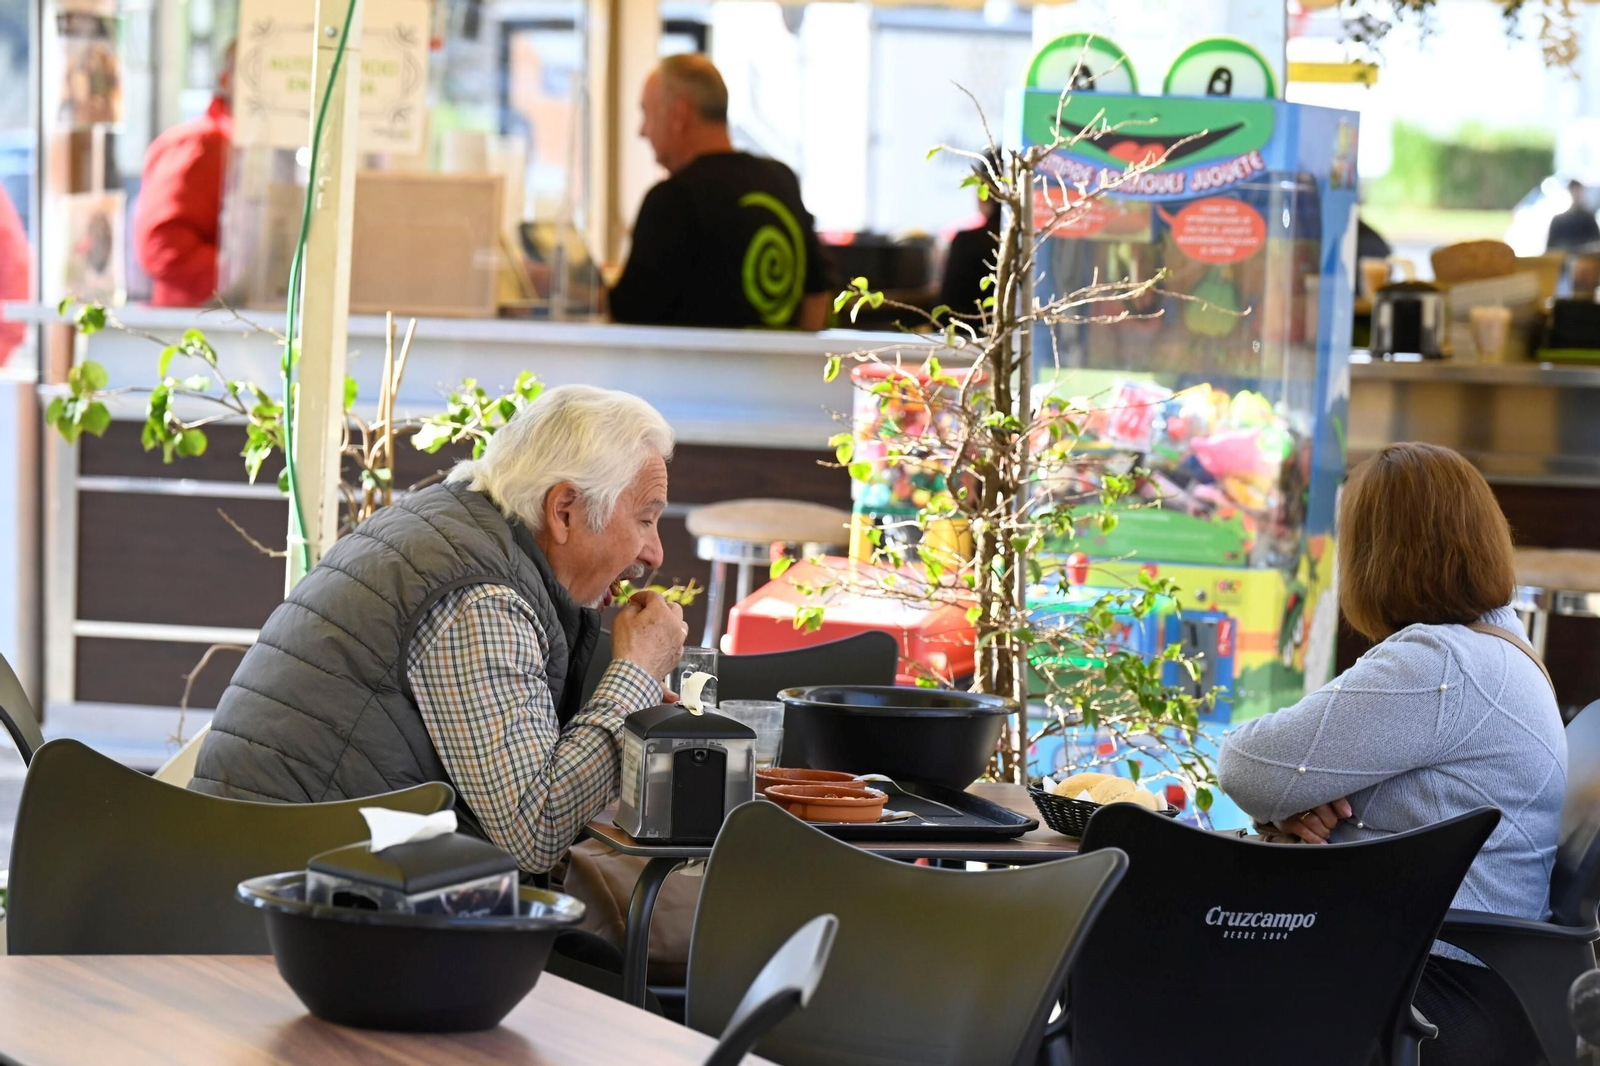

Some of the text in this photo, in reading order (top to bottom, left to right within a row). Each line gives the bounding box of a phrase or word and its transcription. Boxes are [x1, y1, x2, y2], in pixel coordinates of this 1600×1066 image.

[1190, 149, 1265, 192] JUGUETE
[1205, 905, 1316, 931] Cruzcampo
[1223, 931, 1256, 940] DESDE
